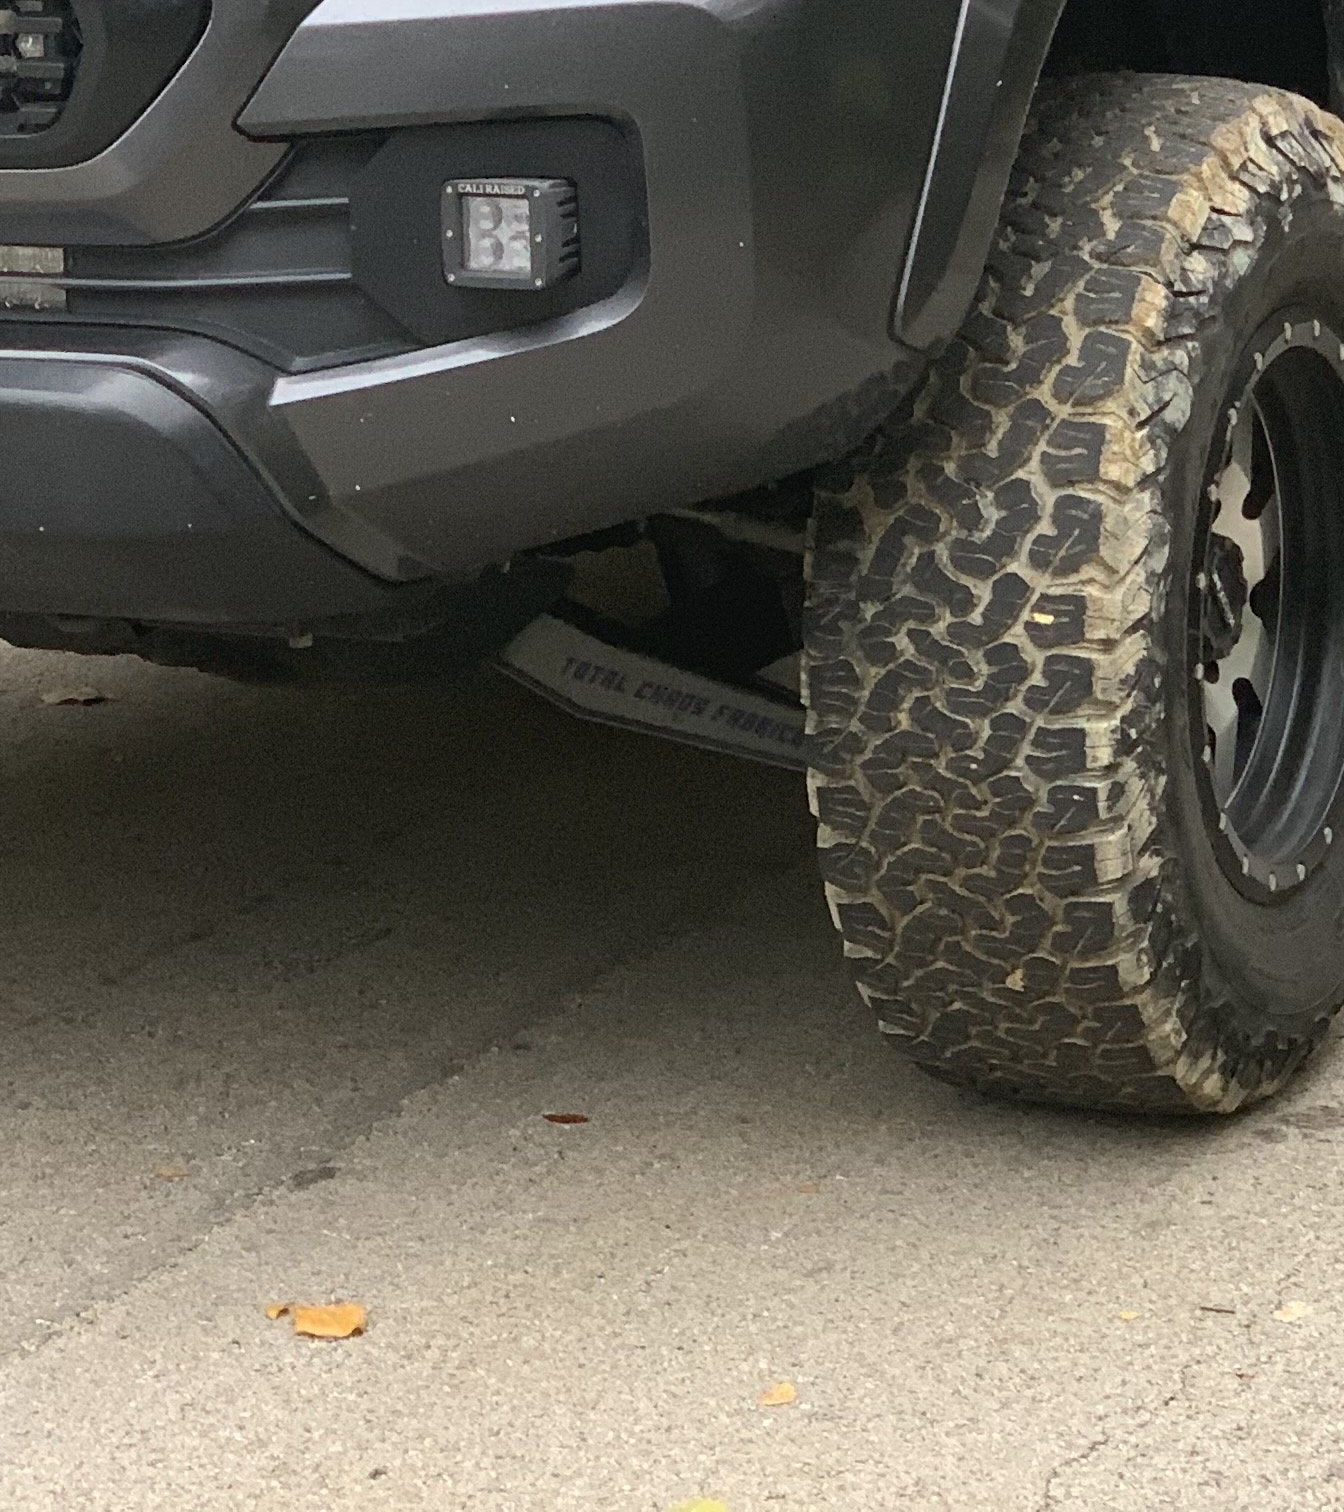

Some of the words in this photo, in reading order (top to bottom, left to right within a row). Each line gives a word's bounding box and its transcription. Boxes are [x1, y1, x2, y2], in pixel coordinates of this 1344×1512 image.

[457, 183, 484, 194] CALI
[485, 184, 525, 195] RAISED
[558, 656, 626, 693] TOTAL
[633, 680, 710, 716] CHAOS
